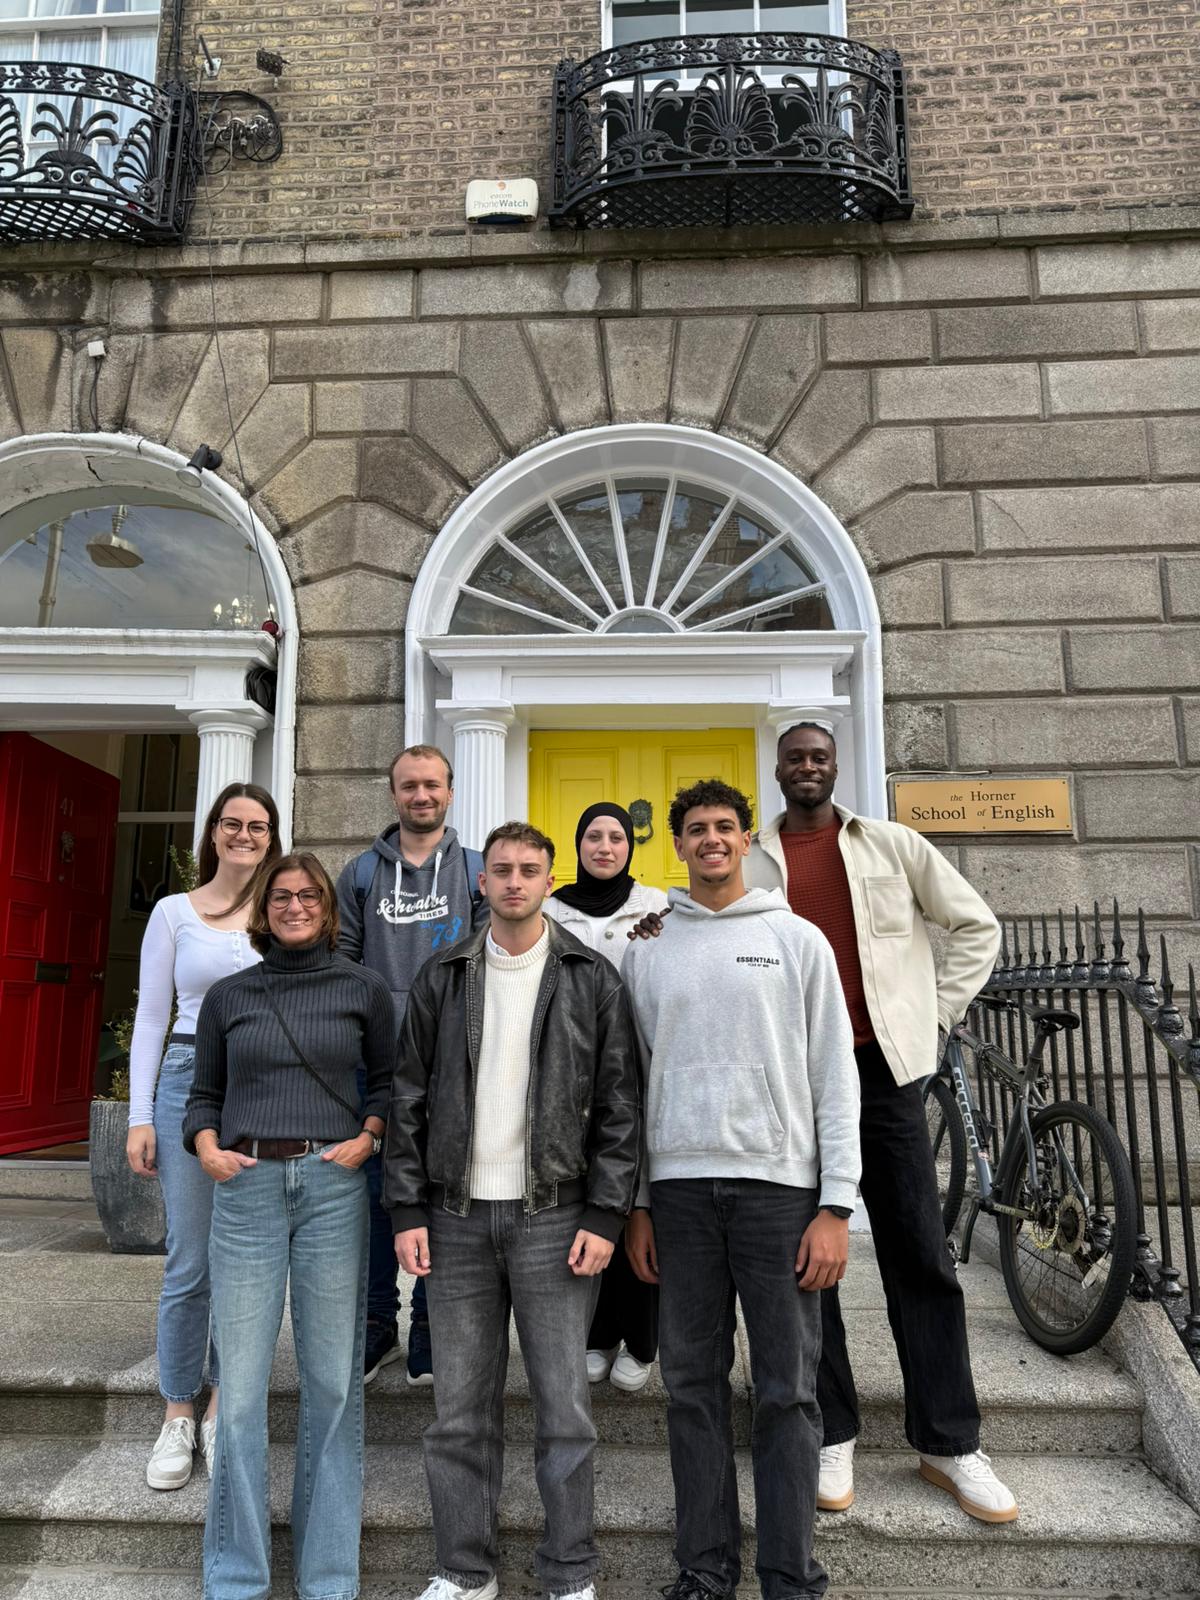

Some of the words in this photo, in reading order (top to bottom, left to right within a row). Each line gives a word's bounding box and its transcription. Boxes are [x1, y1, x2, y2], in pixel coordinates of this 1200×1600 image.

[473, 199, 529, 209] PhoneWatch
[950, 794, 963, 802] the
[970, 790, 1016, 801] Horner
[60, 797, 74, 817] 41
[911, 806, 966, 820] School
[976, 808, 986, 817] of
[991, 804, 1055, 822] English
[420, 910, 444, 920] TIRES
[736, 956, 780, 966] ESSENTIALS
